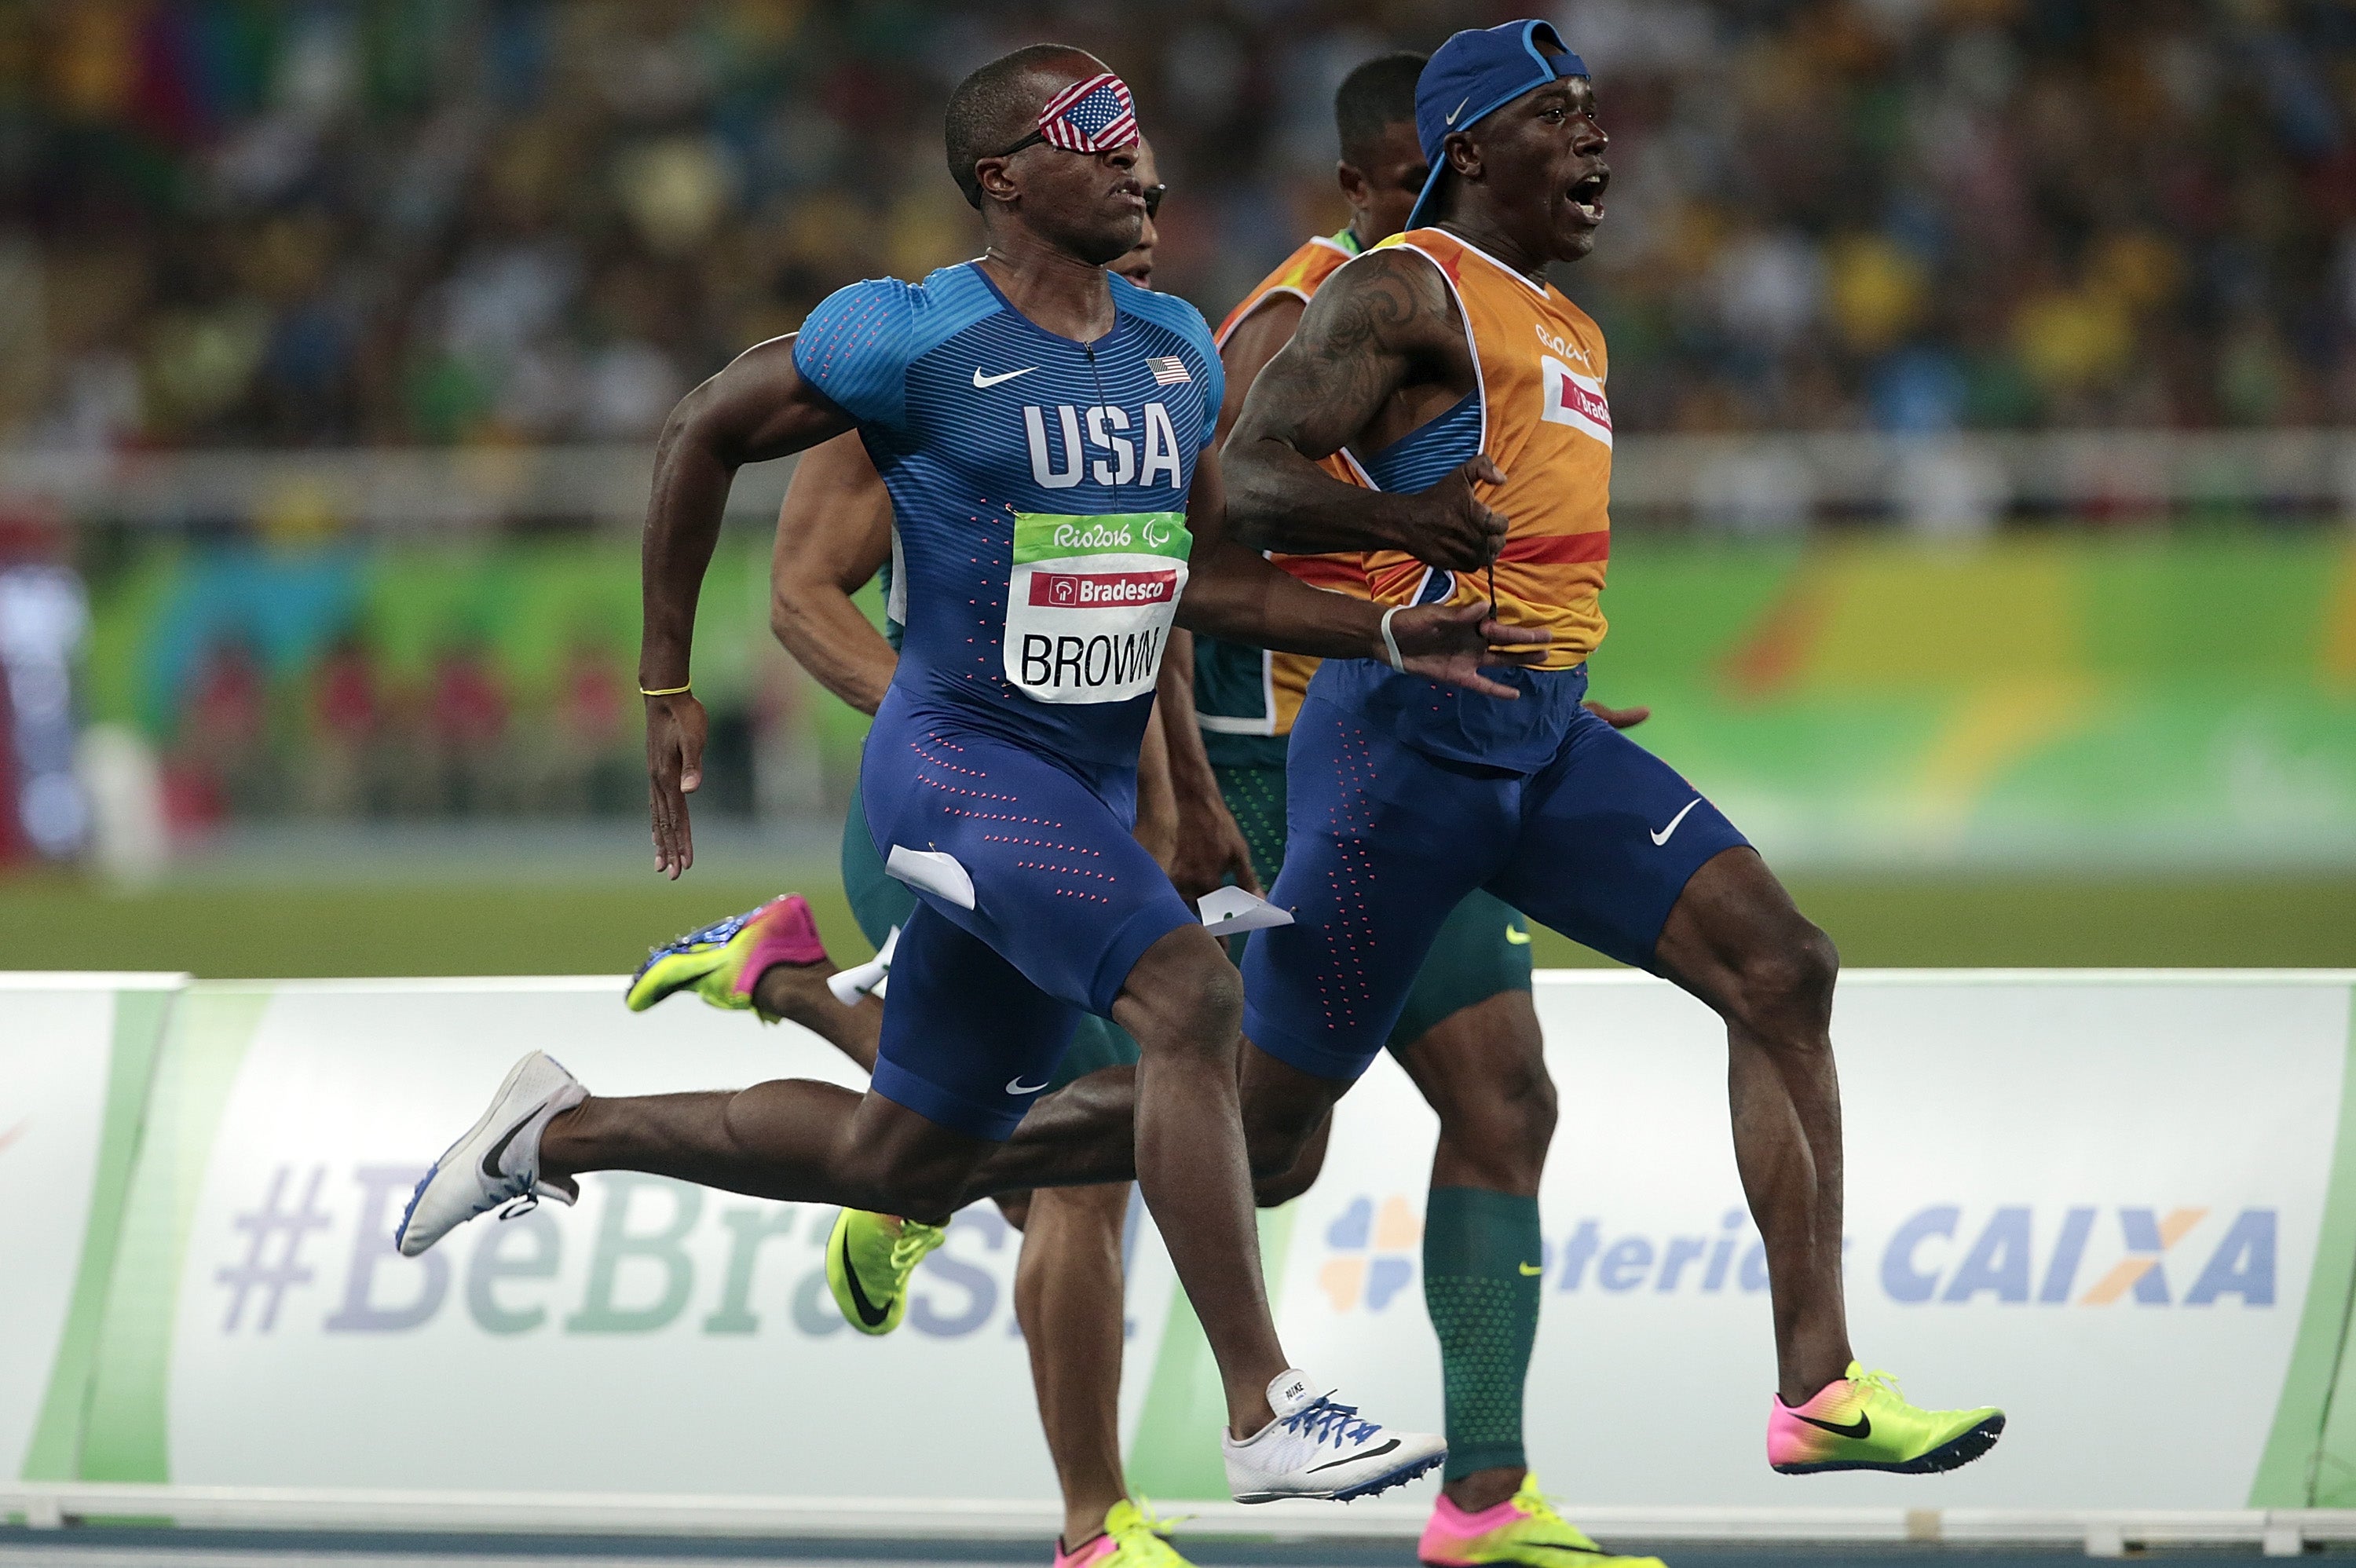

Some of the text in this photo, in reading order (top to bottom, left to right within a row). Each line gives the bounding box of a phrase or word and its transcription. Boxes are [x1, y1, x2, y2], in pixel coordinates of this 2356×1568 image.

[1023, 403, 1181, 489] USA
[1054, 523, 1132, 548] Rio2016
[1080, 579, 1164, 602] Bradesco
[1022, 627, 1160, 688] BROWN
[214, 1165, 1136, 1336] #BeBrs
[1879, 1203, 2277, 1306] CAIXA
[1285, 1381, 1304, 1400] NIKE
